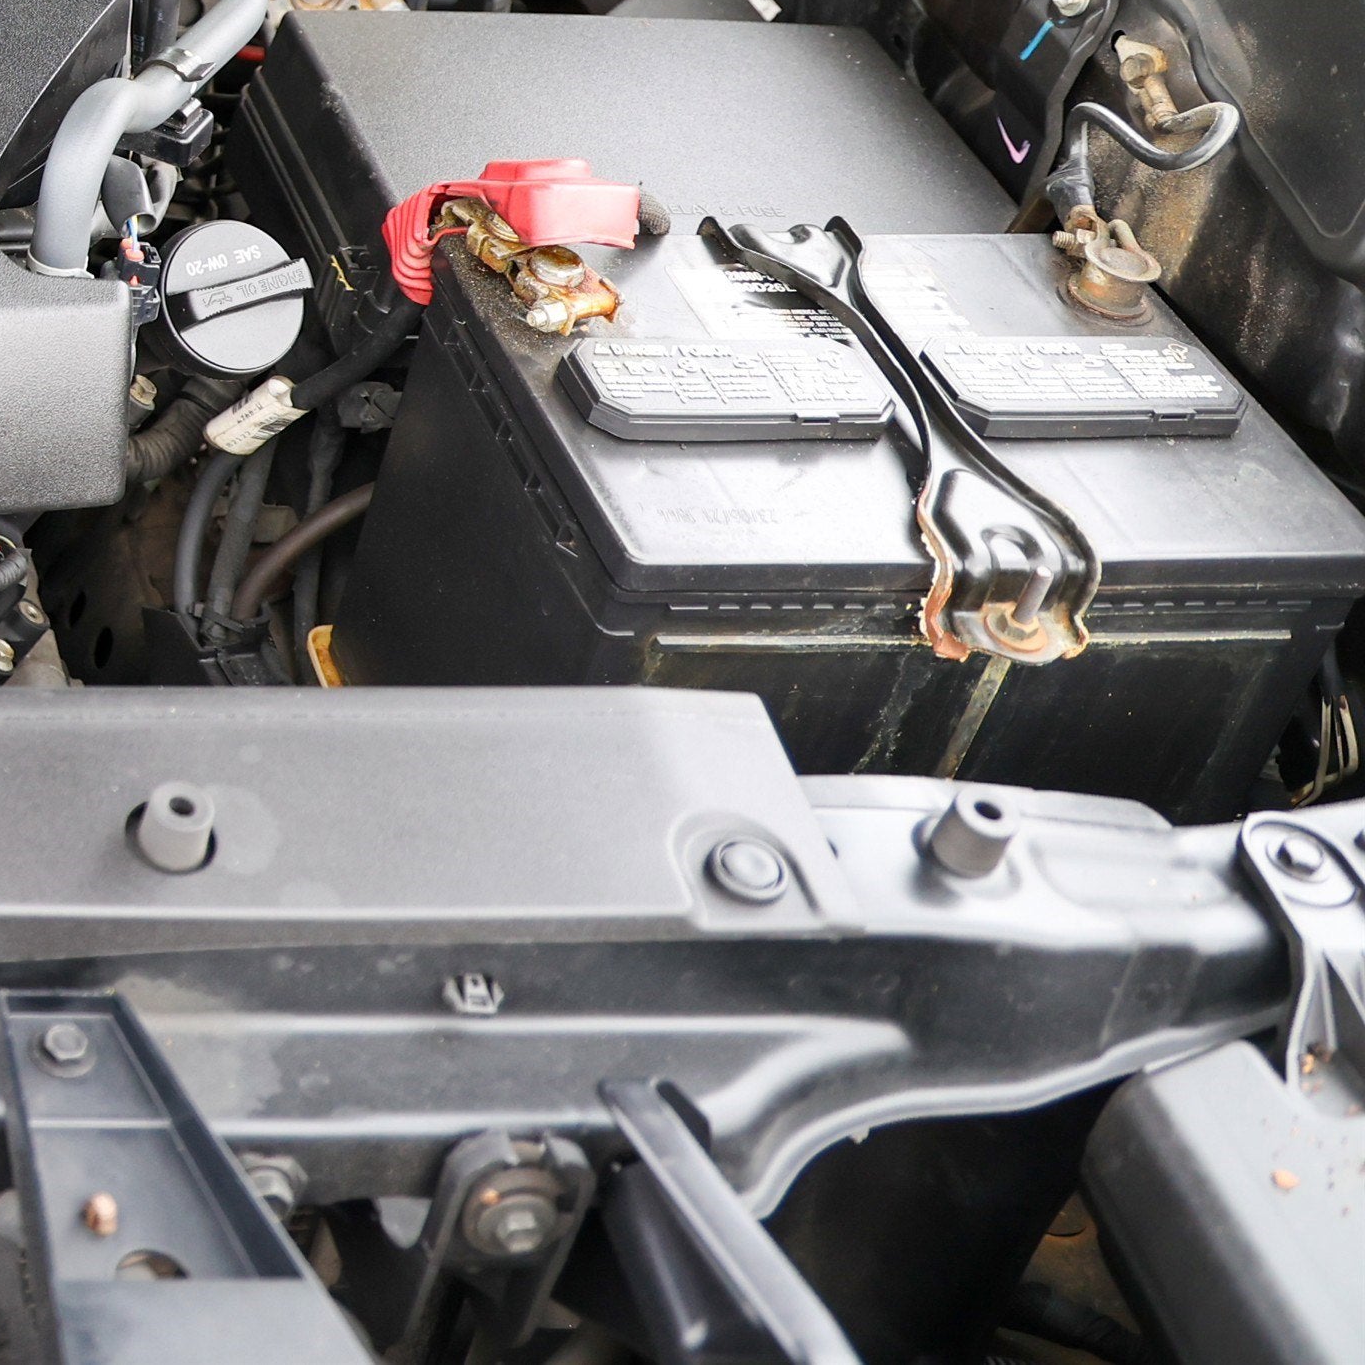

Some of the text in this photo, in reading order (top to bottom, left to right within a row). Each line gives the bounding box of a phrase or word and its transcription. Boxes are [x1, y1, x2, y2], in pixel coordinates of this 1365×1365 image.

[738, 205, 786, 218] FUSE
[185, 244, 262, 277] SAE 0W-20
[236, 268, 306, 300] ENGINE OIL
